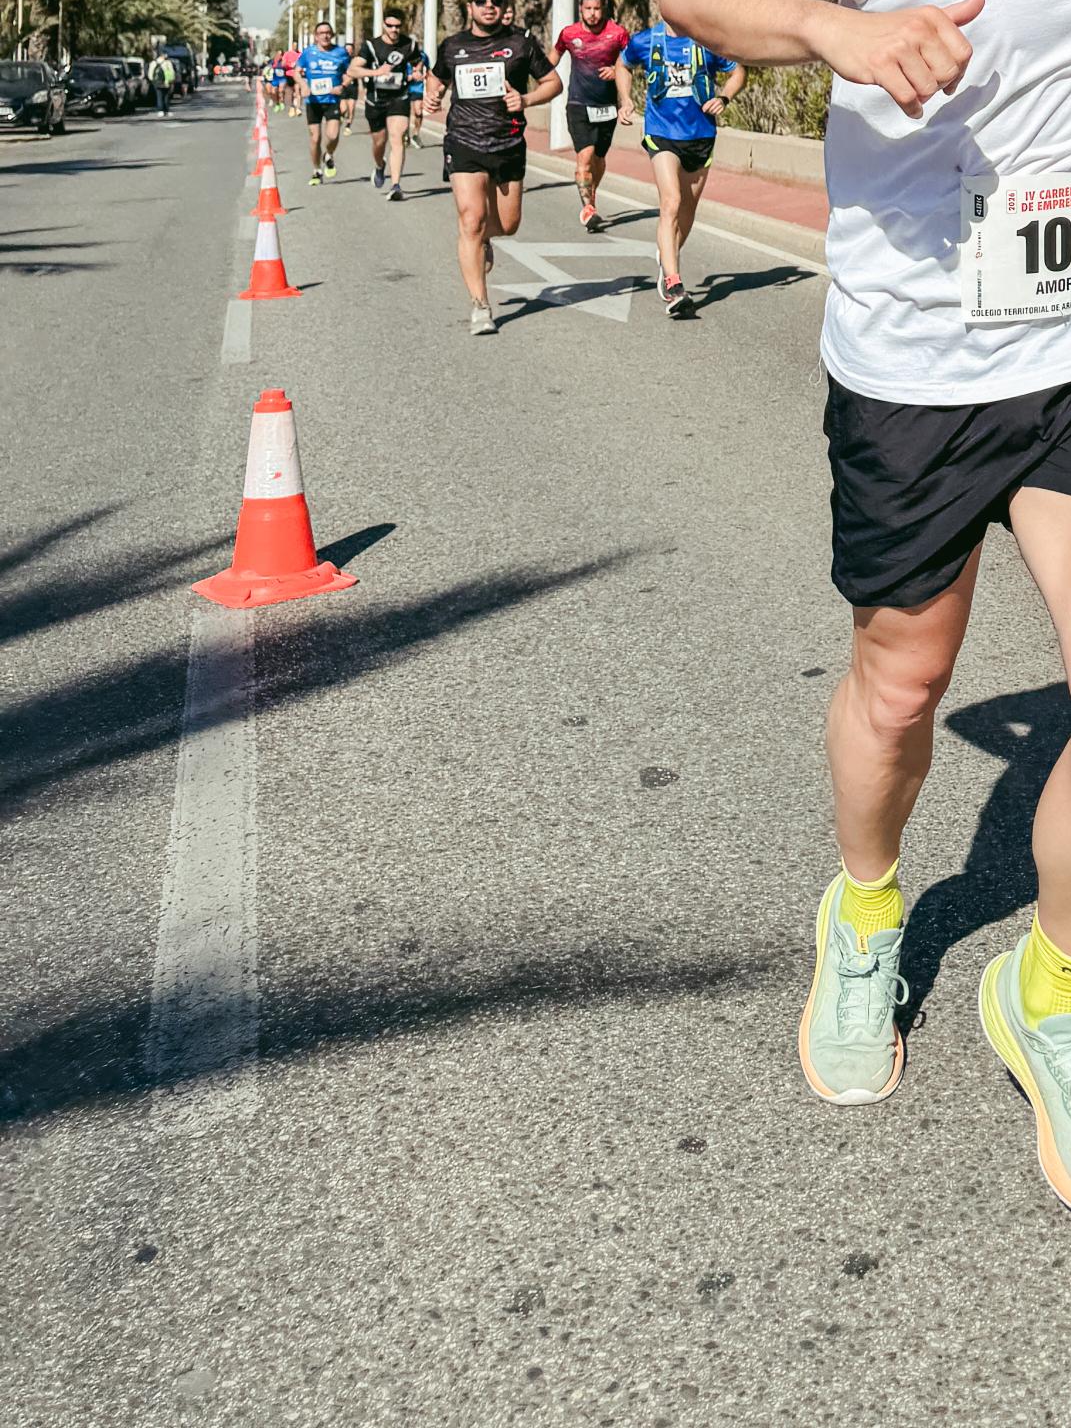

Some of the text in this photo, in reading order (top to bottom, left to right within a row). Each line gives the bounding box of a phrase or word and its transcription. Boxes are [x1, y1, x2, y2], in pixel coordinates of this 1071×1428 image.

[473, 74, 488, 87] 81
[1008, 192, 1016, 211] 2026
[1025, 190, 1036, 201] IV
[1021, 202, 1034, 212] DE
[971, 308, 1002, 317] COLEGIO
[1003, 305, 1050, 316] TERRITORIAL
[1051, 303, 1060, 312] DE
